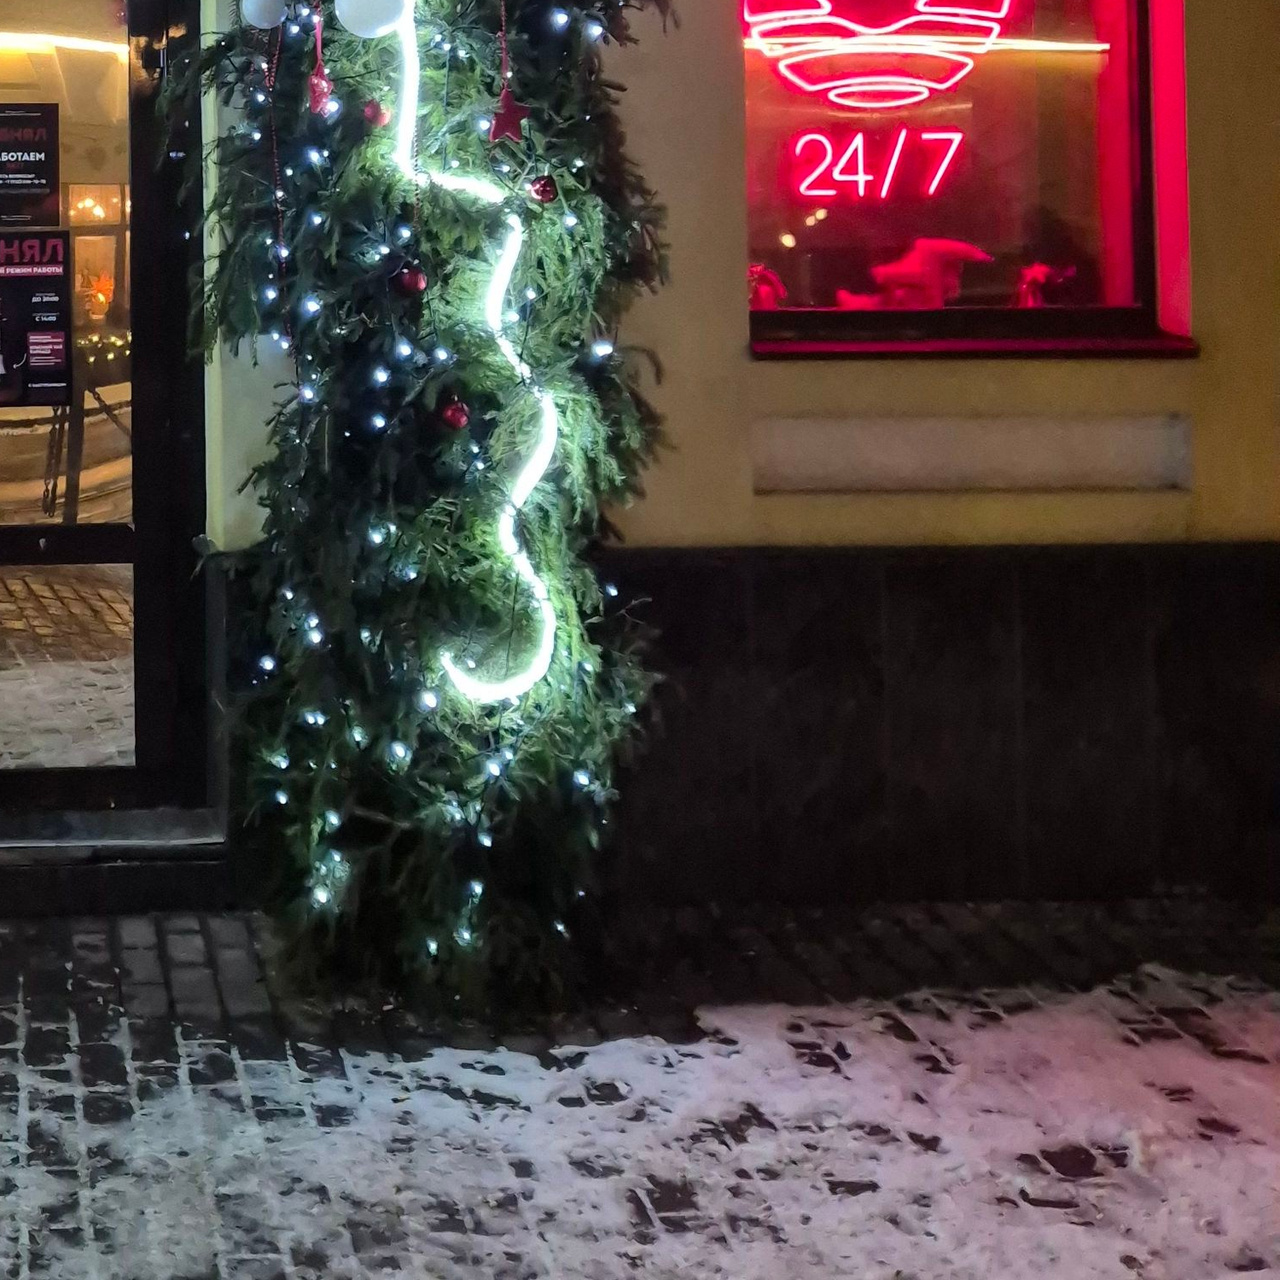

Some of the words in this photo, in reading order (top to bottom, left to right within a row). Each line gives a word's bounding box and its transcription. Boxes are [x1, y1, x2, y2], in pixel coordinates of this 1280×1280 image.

[794, 128, 965, 199] 24/7
[6, 266, 32, 274] РЕЖИМ
[33, 265, 63, 273] РАБОТЫ
